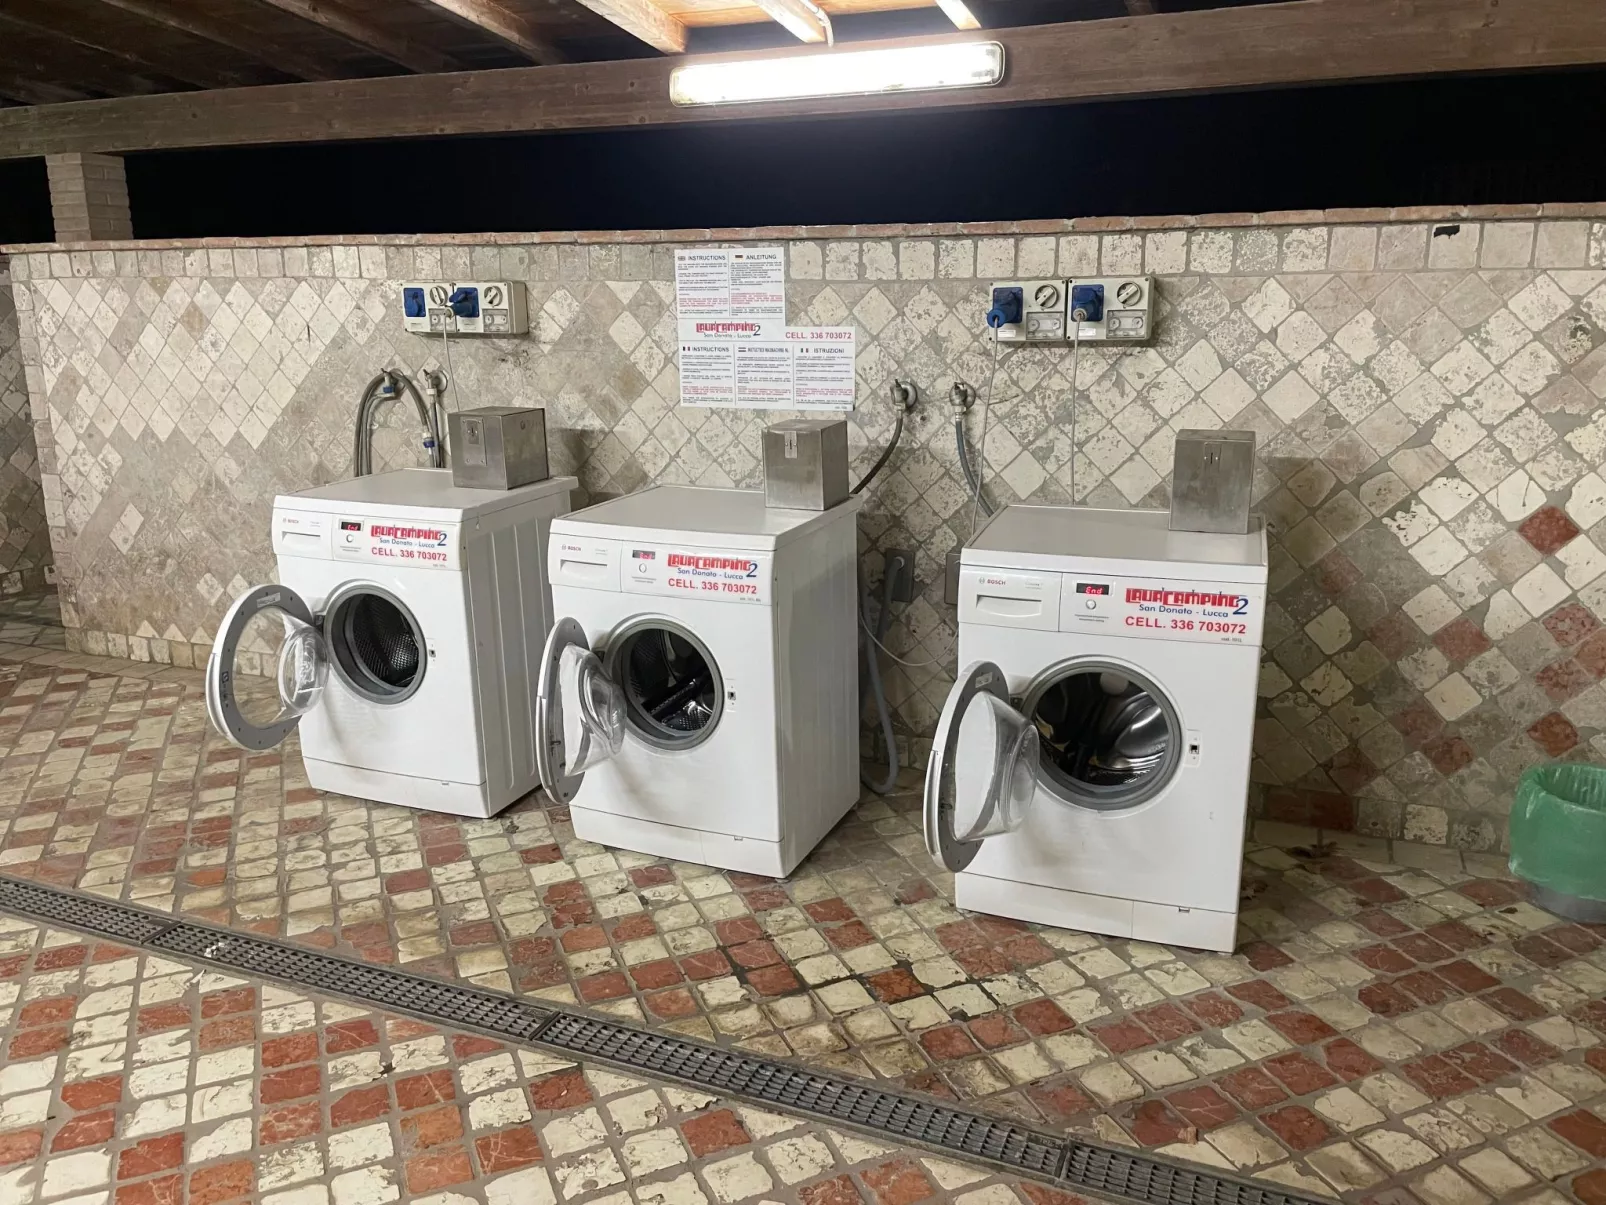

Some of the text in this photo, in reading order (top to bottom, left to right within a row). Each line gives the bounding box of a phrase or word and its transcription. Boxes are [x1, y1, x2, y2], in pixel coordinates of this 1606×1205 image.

[753, 324, 761, 336] 2
[437, 532, 448, 546] 2
[372, 547, 398, 557] CELL.
[400, 550, 414, 558] 336
[417, 551, 448, 561] 703072
[724, 572, 744, 580] Lucca
[746, 563, 758, 578] 2
[668, 578, 698, 589] CELL.
[702, 580, 718, 591] 336
[722, 583, 757, 594] 703072
[1085, 586, 1103, 595] End
[1159, 605, 1192, 614] Donato
[1202, 608, 1228, 618] Lucca
[1232, 598, 1249, 615] 2
[1125, 616, 1166, 628] CELL.
[1170, 619, 1194, 630] 336
[1198, 621, 1246, 634] 703072
